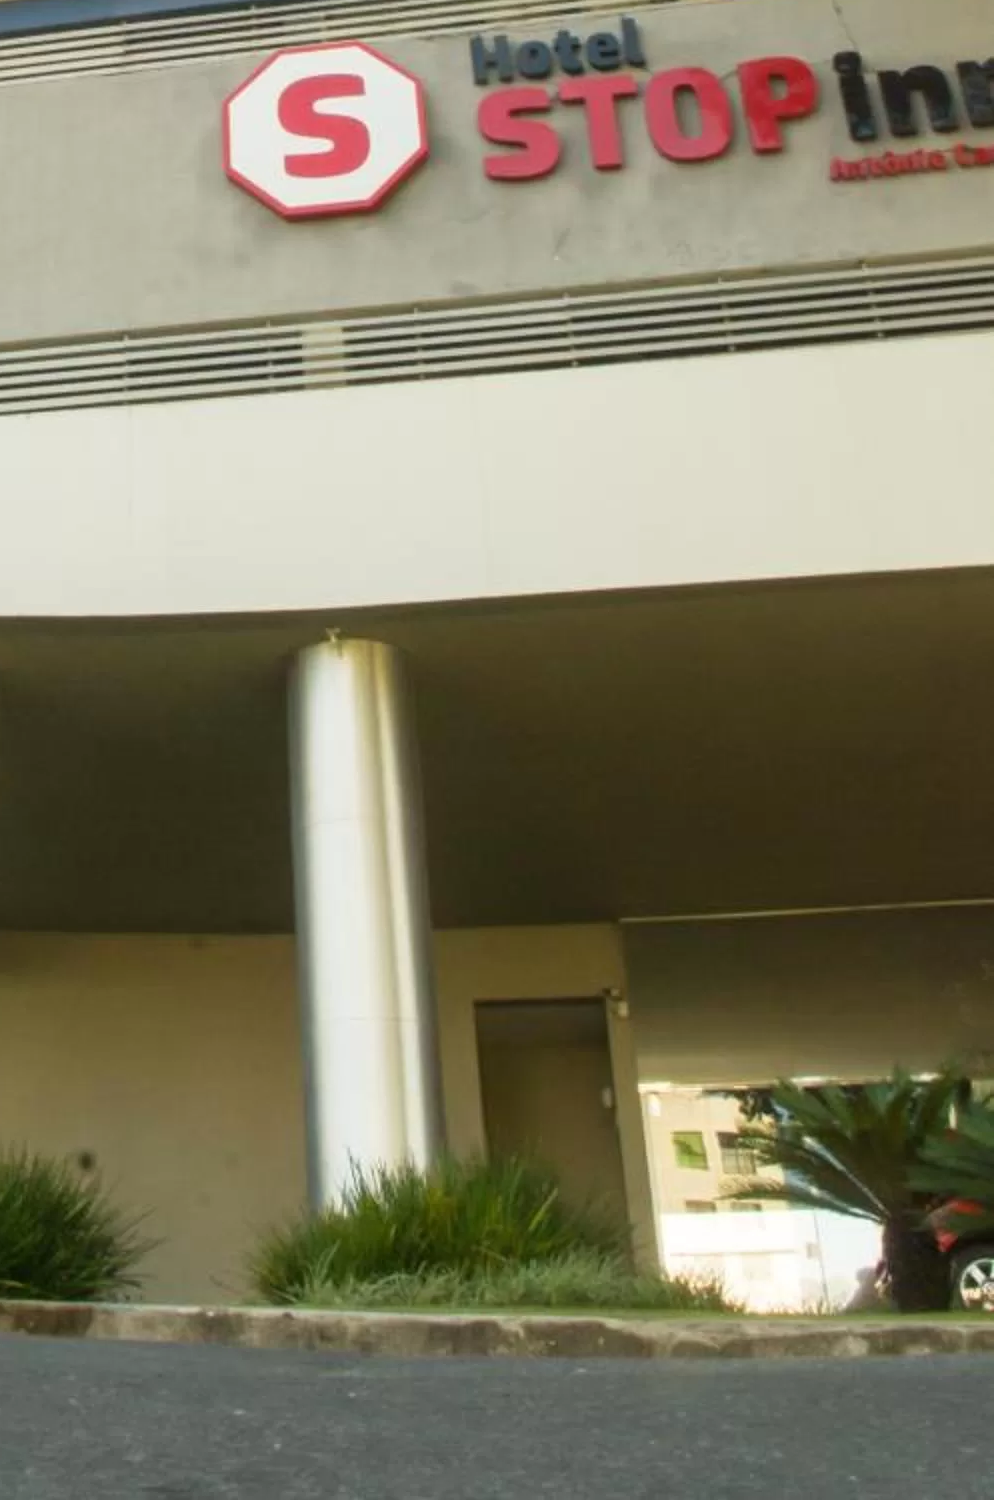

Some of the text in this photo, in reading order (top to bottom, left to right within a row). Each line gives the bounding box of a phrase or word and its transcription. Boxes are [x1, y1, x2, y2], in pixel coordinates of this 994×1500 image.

[470, 14, 646, 85] Hotel
[277, 73, 371, 178] S
[478, 56, 819, 181] STOP
